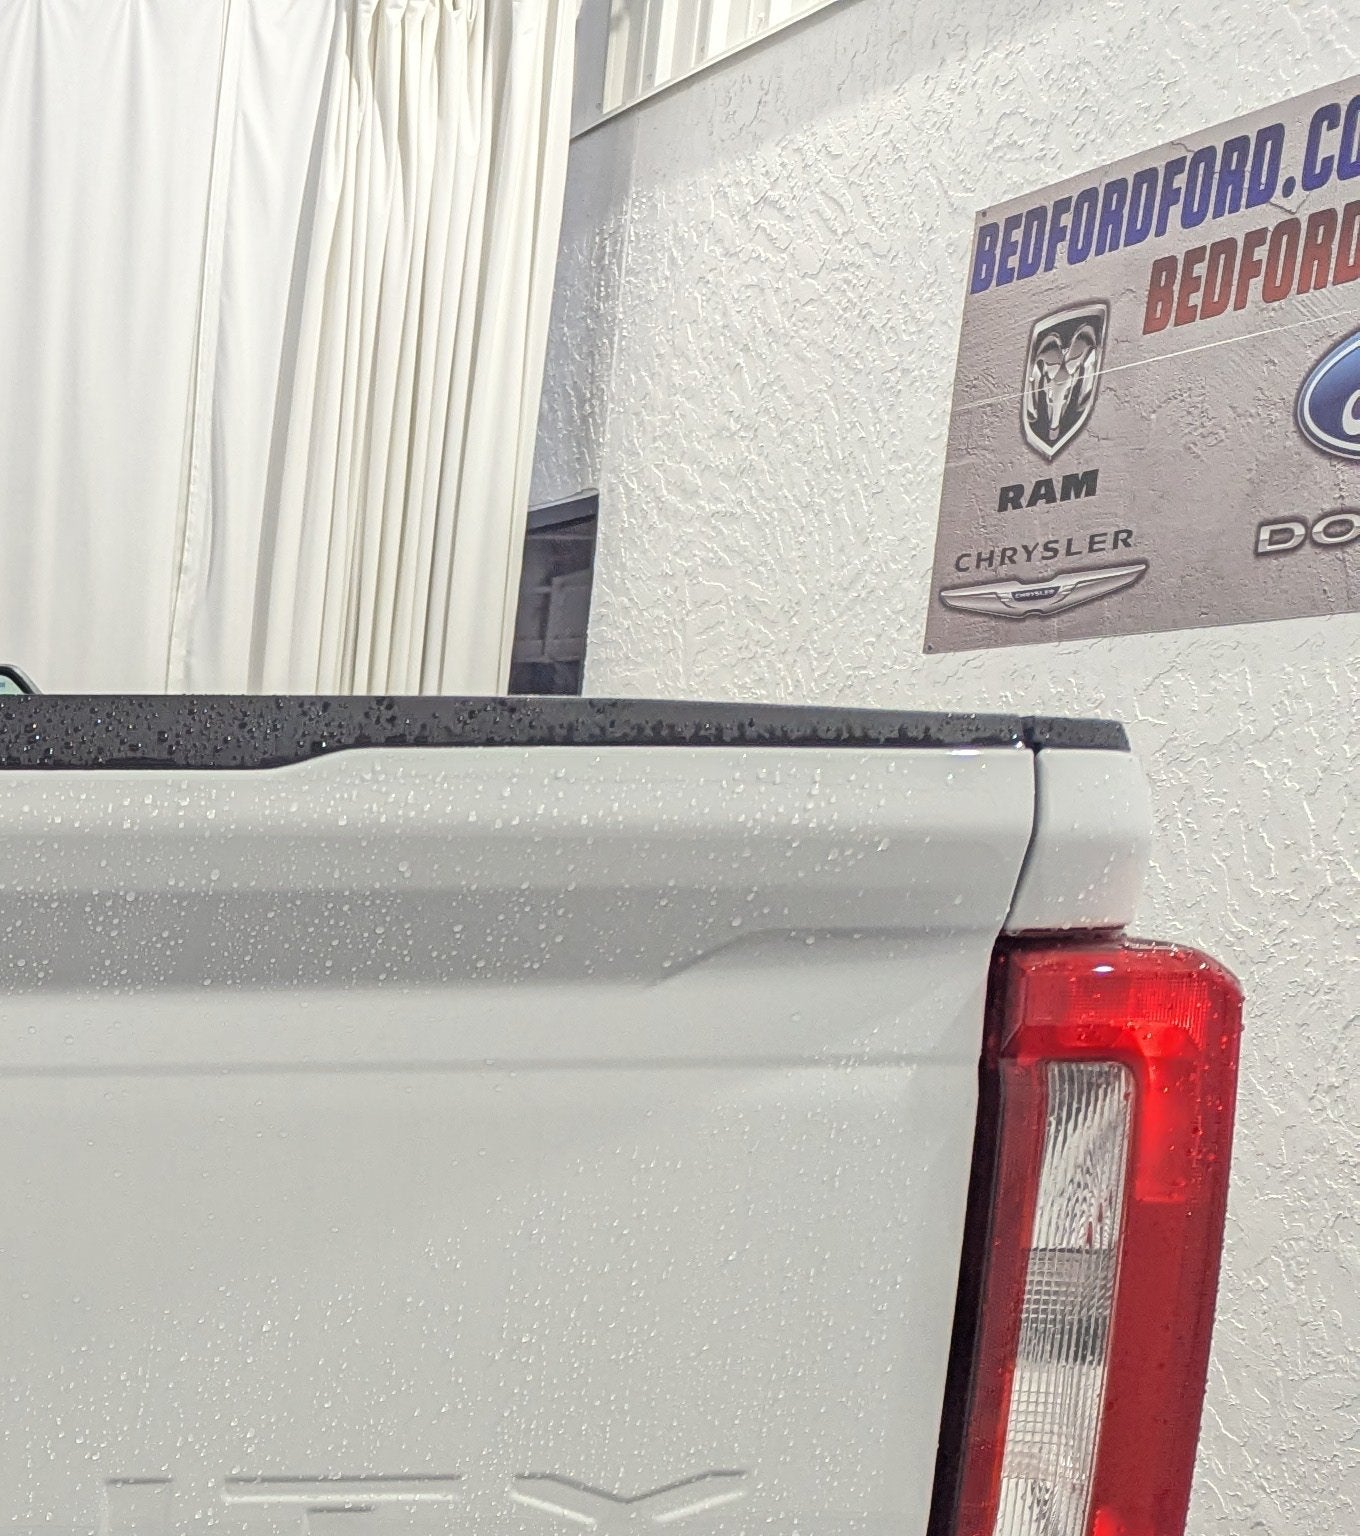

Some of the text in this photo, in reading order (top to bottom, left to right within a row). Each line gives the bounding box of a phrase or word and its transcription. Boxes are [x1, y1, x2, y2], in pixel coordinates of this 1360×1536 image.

[1142, 198, 1360, 336] BEDFORD
[997, 469, 1099, 512] RAM
[954, 529, 1134, 573] CHRYSLER
[1256, 512, 1360, 554] DO
[1013, 588, 1056, 599] CHRYSLER
